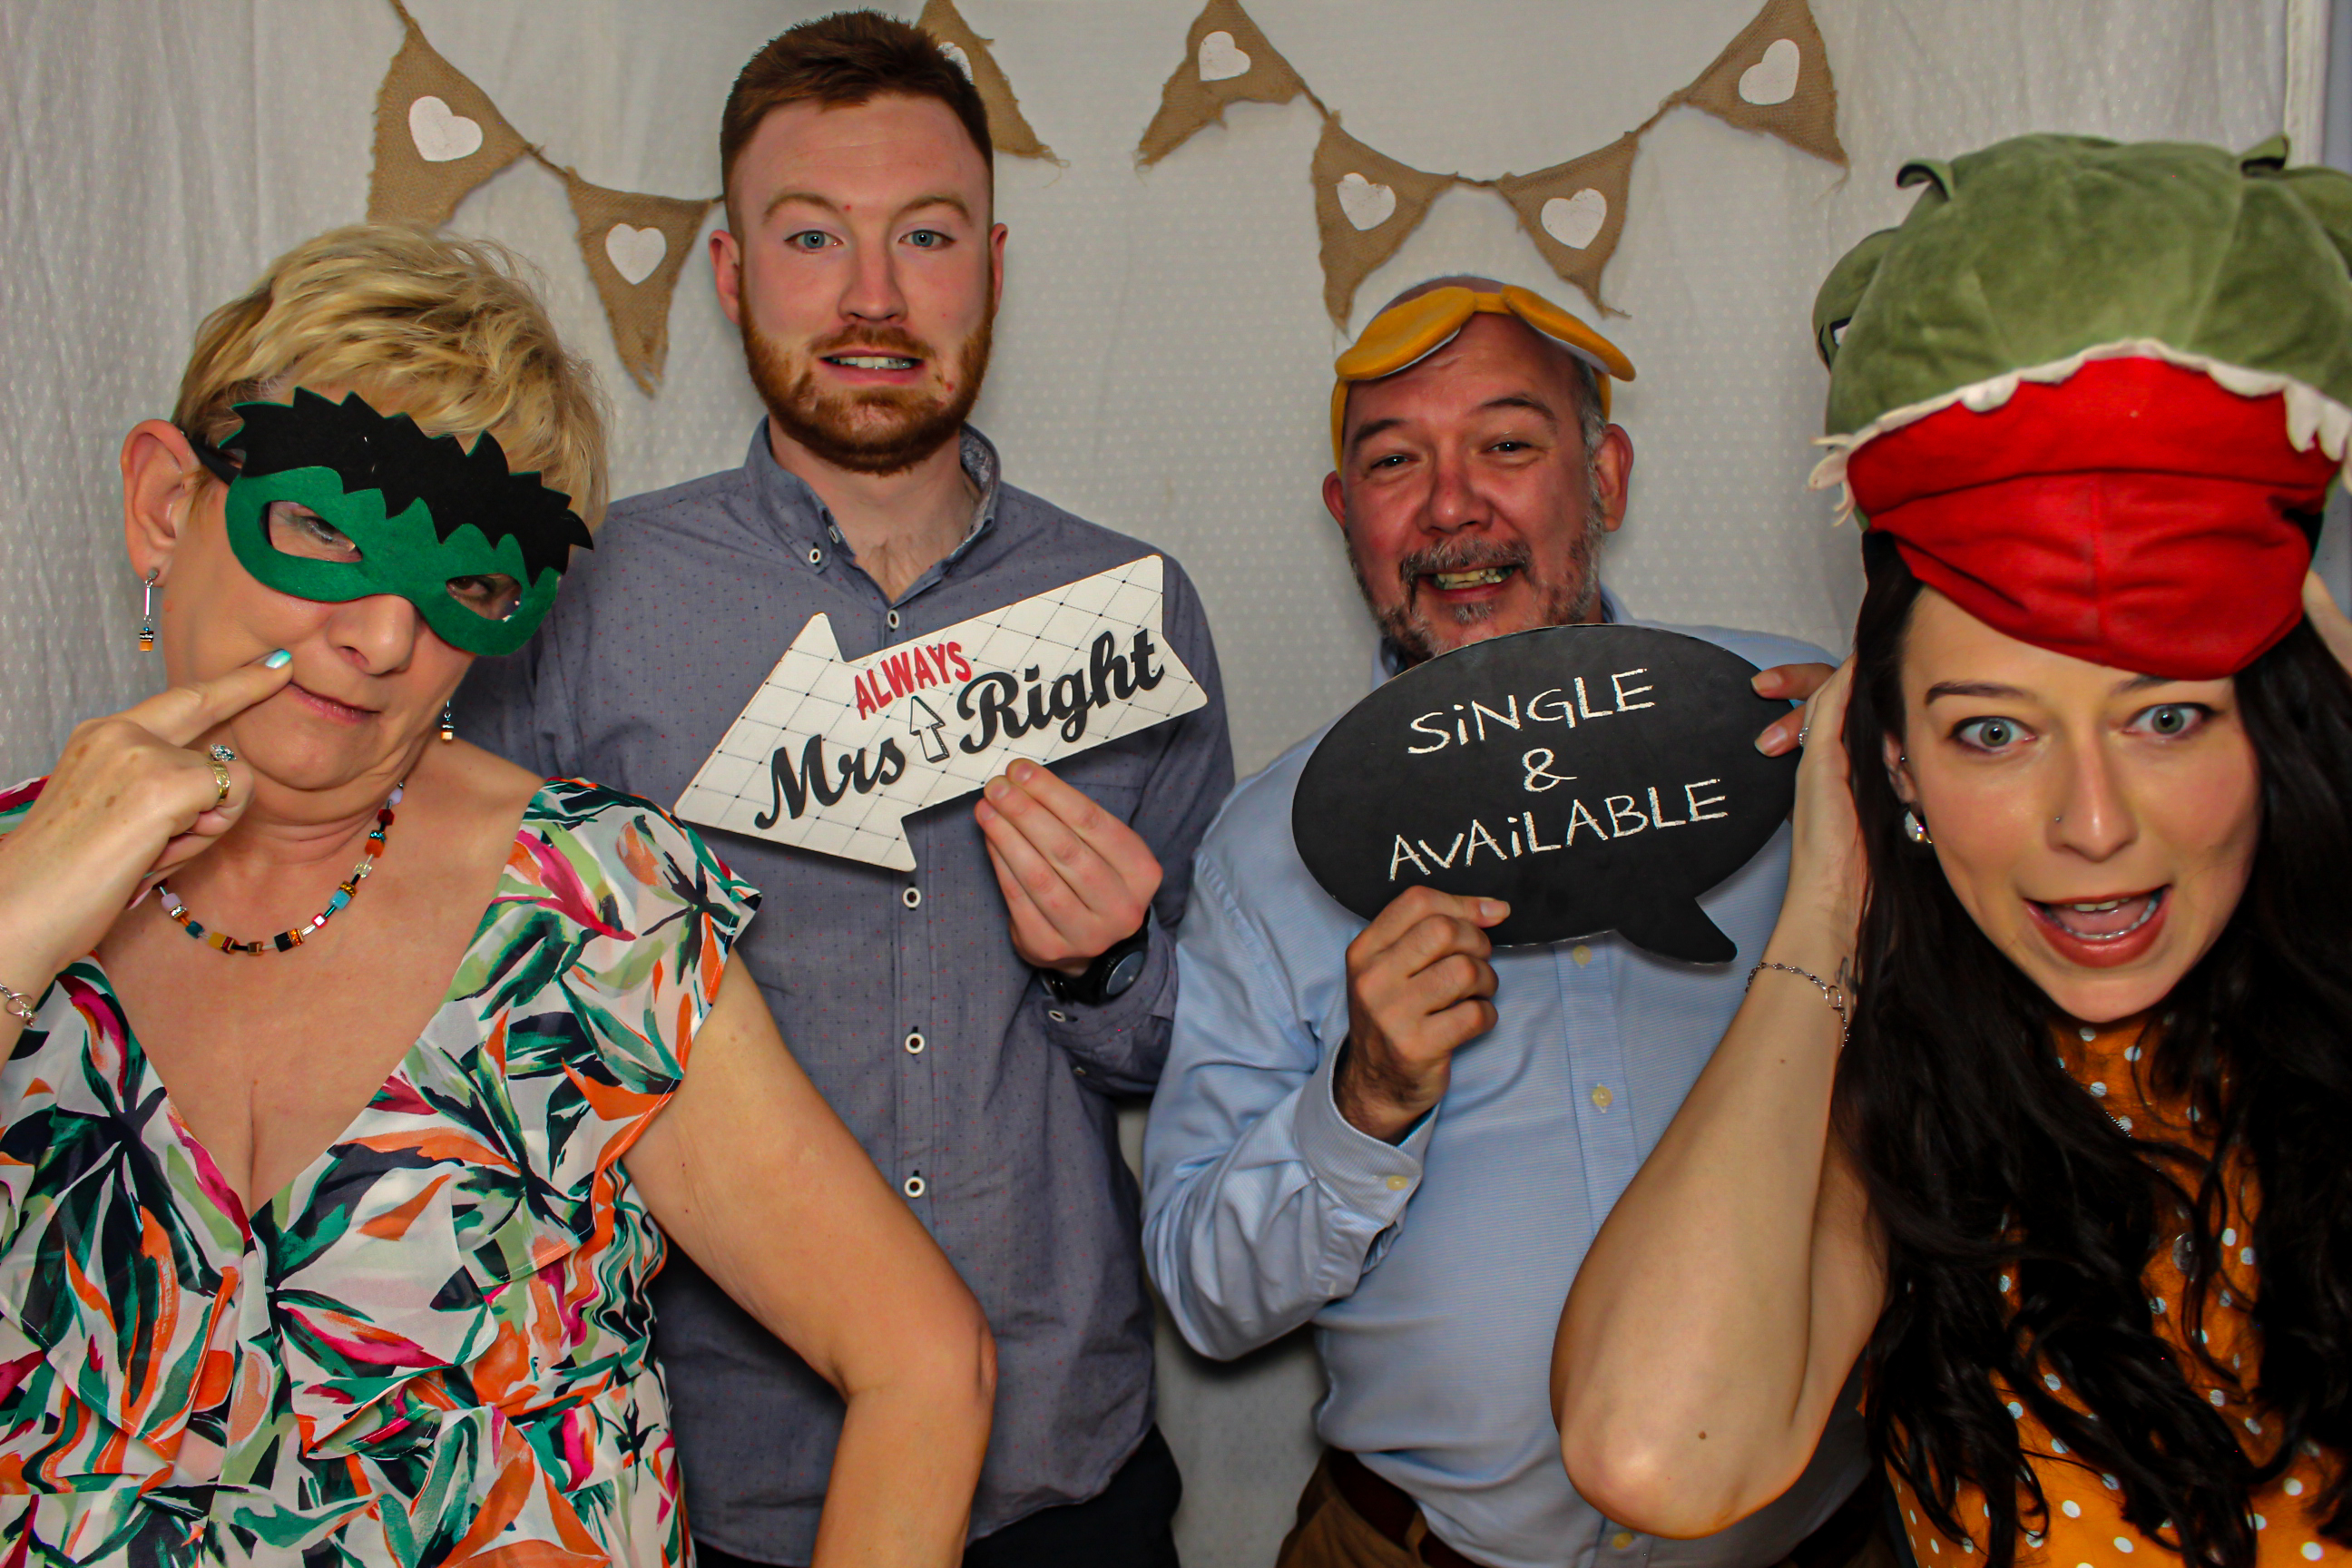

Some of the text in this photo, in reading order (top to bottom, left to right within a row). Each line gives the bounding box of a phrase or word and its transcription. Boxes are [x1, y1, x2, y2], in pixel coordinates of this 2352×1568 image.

[853, 641, 973, 720] ALWAYS
[753, 627, 1165, 829] Mrs Right
[1522, 748, 1578, 793] &
